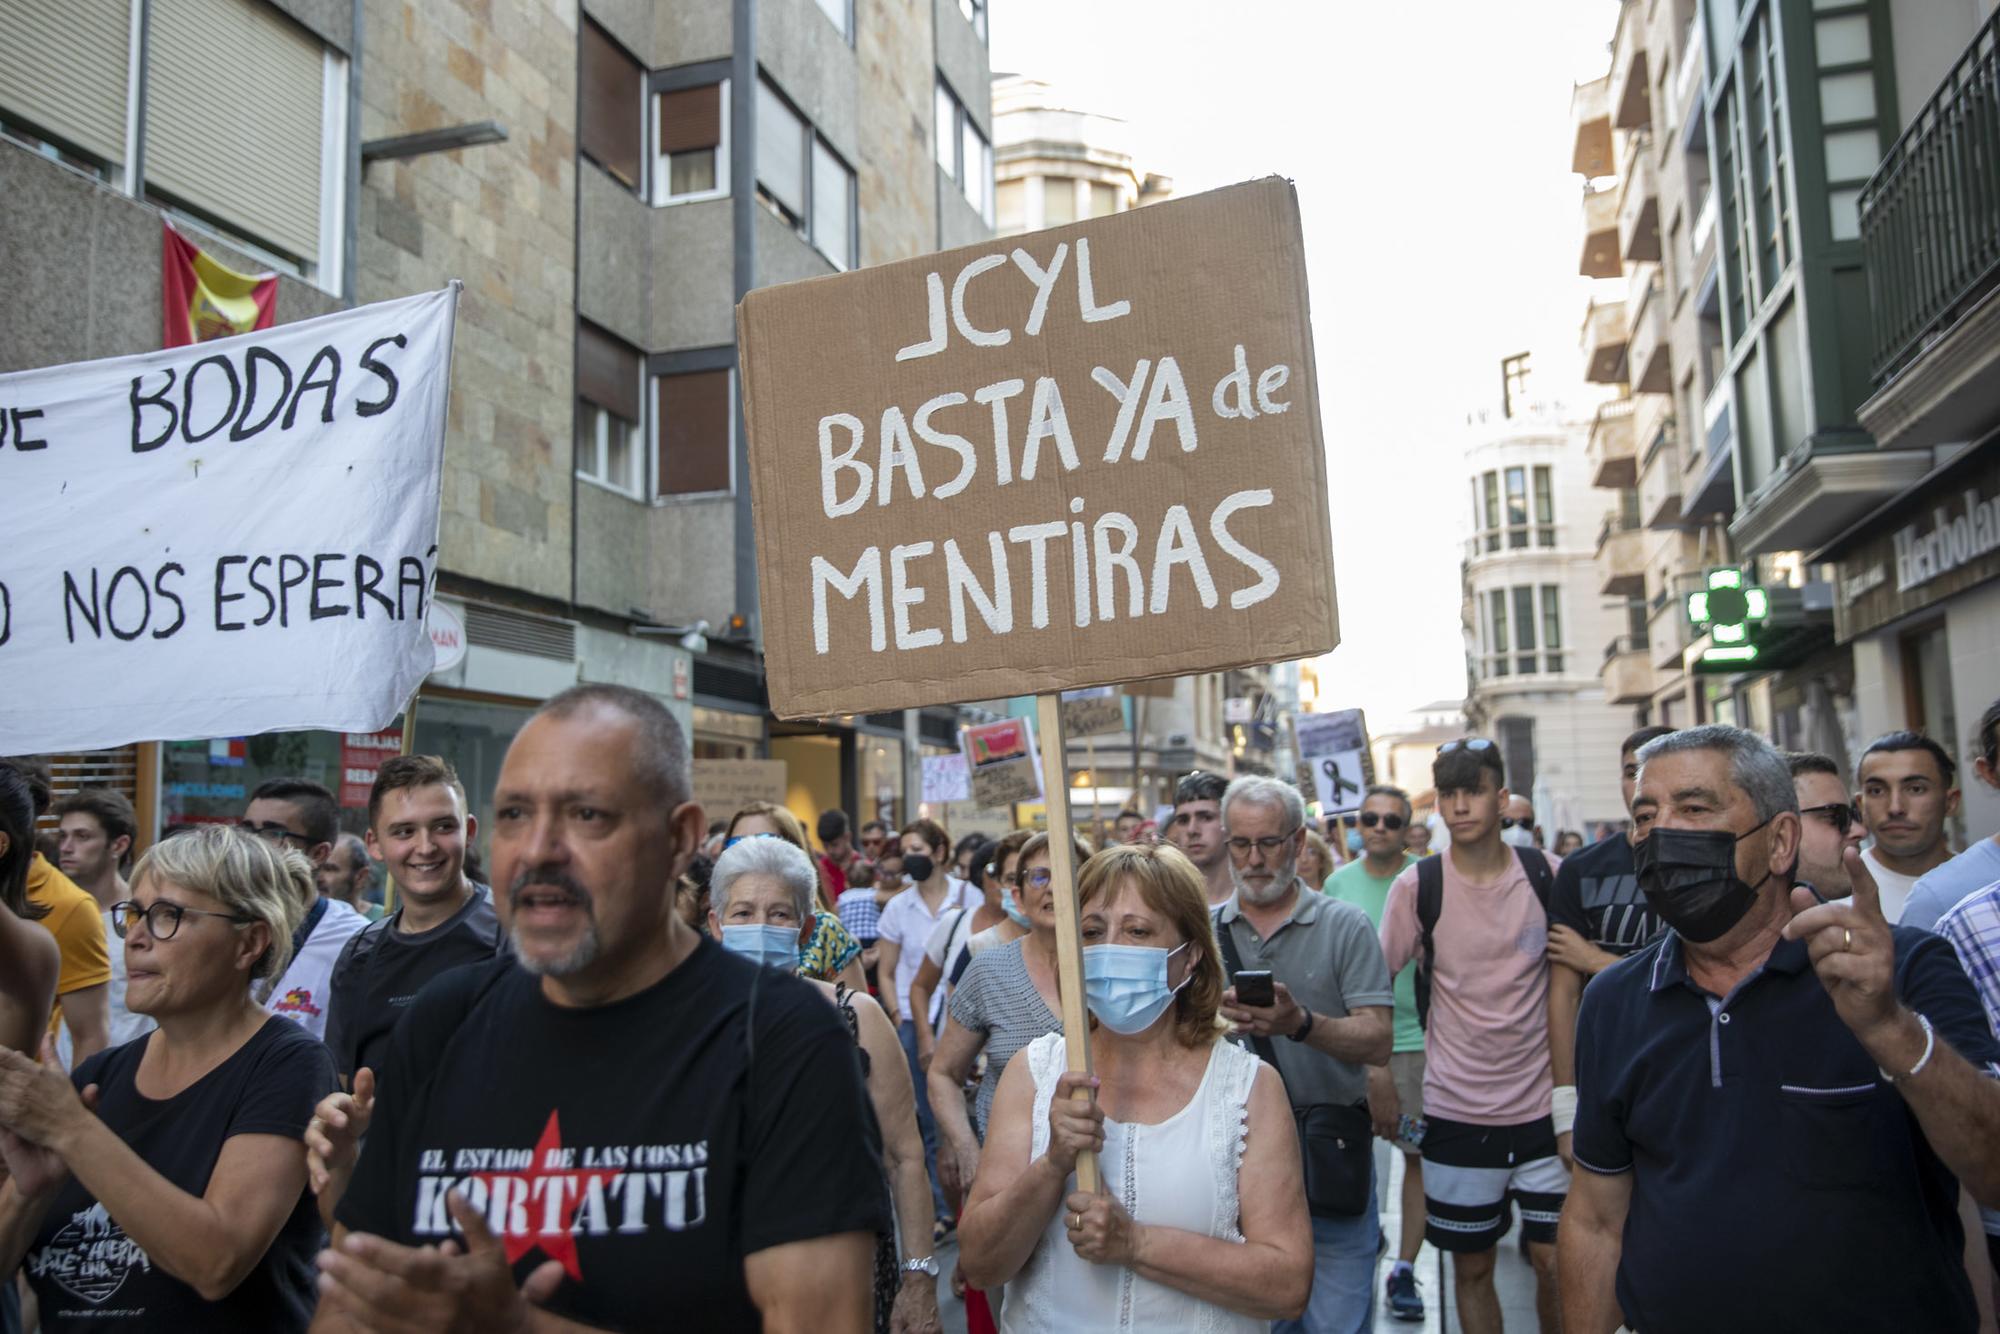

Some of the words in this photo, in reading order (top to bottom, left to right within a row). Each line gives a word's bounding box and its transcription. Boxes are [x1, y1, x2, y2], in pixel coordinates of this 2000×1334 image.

[896, 238, 1131, 361] JCYL
[130, 333, 408, 453] BODAS
[818, 376, 1080, 518] BASTA
[1091, 357, 1198, 463] YA
[1212, 344, 1292, 420] de
[63, 563, 186, 642] NOS
[412, 1167, 708, 1236] KORTATU
[420, 1150, 446, 1170] EL
[454, 1148, 533, 1169] ESTADO
[543, 1147, 576, 1168] DE
[583, 1146, 629, 1168] LAS
[632, 1140, 708, 1166] COSAS
